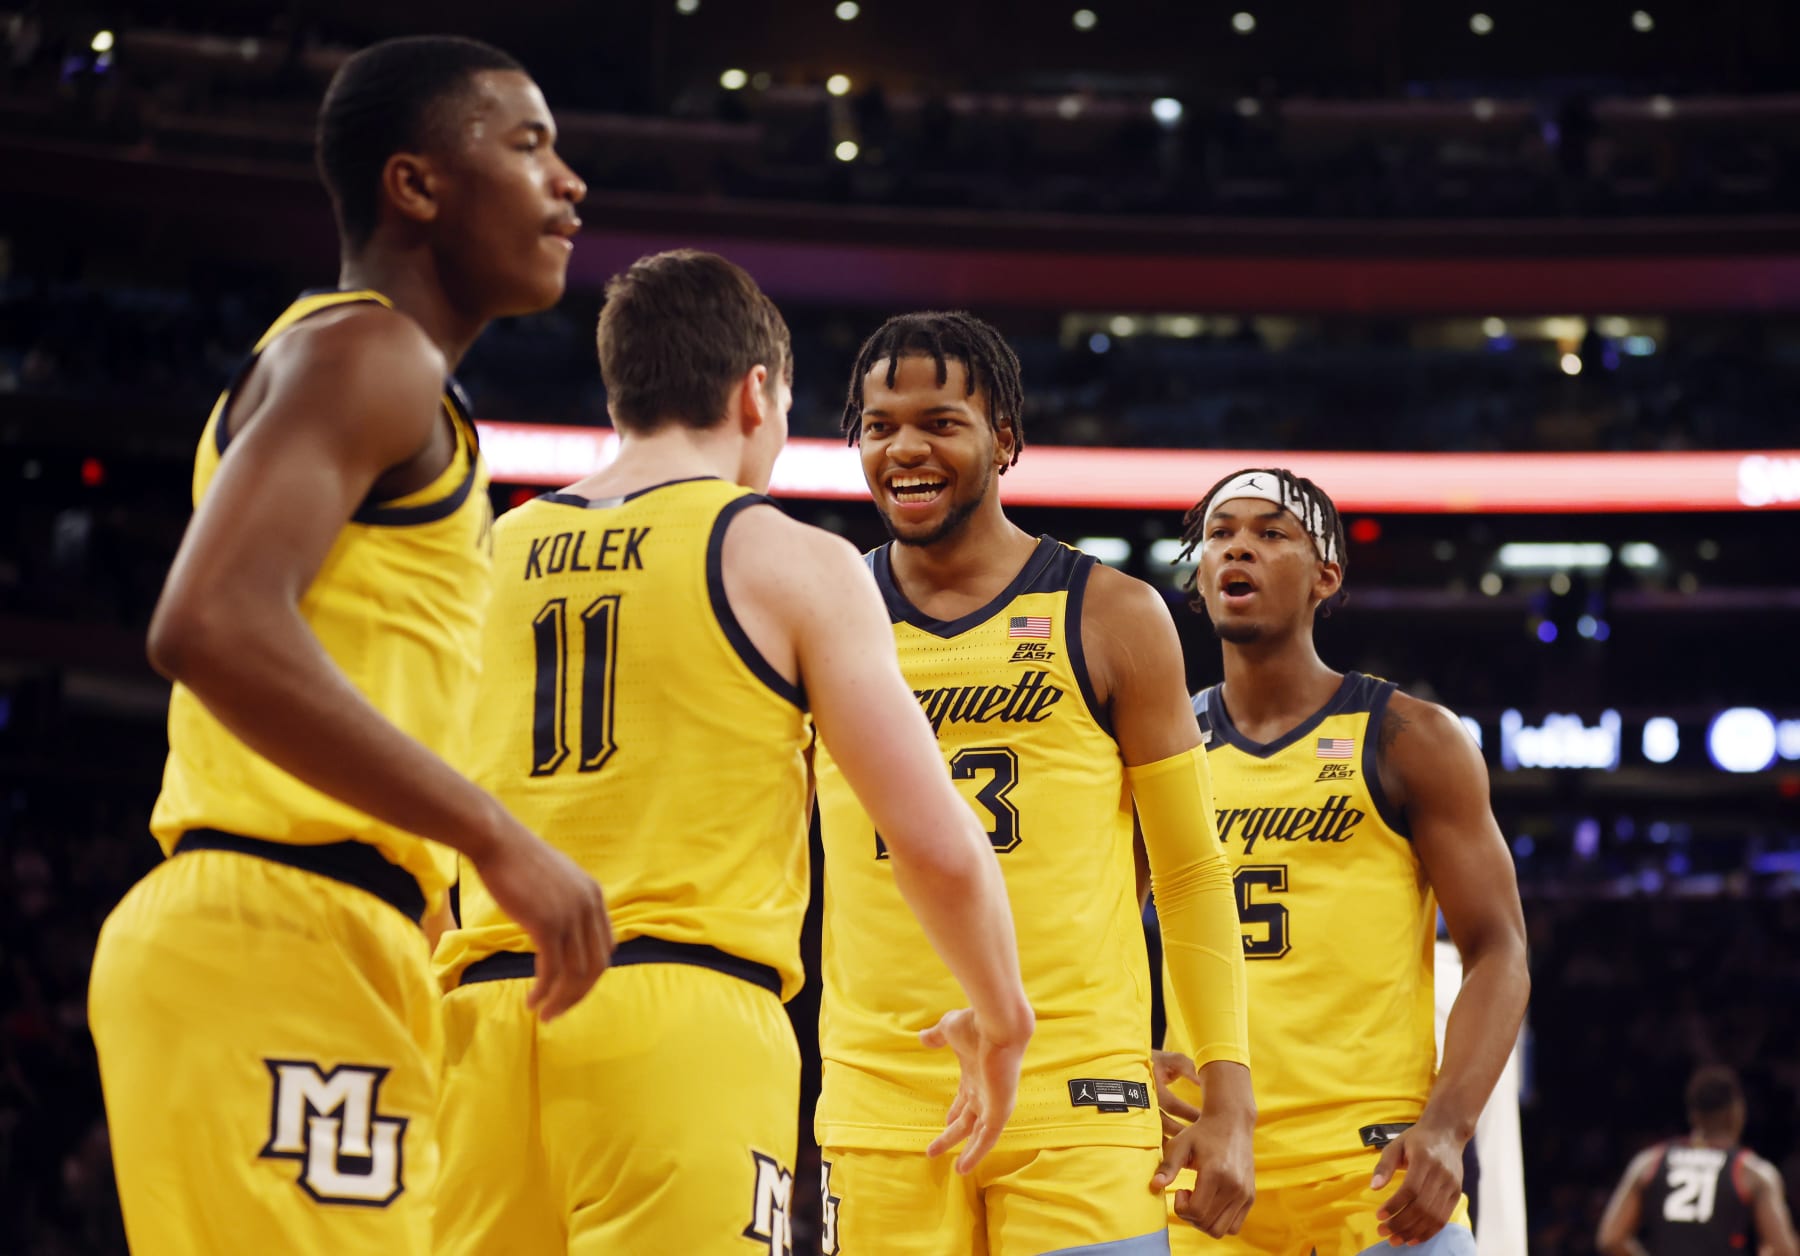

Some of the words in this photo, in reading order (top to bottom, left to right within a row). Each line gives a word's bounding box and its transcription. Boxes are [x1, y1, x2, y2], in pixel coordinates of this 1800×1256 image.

[524, 526, 652, 581] KOLEK
[1012, 651, 1056, 660] EAST
[1017, 643, 1048, 651] BIG
[529, 593, 622, 778] 11
[1318, 770, 1356, 778] EAST
[1127, 1088, 1139, 1100] 48
[258, 1059, 410, 1208] MU
[1663, 1167, 1720, 1224] 21
